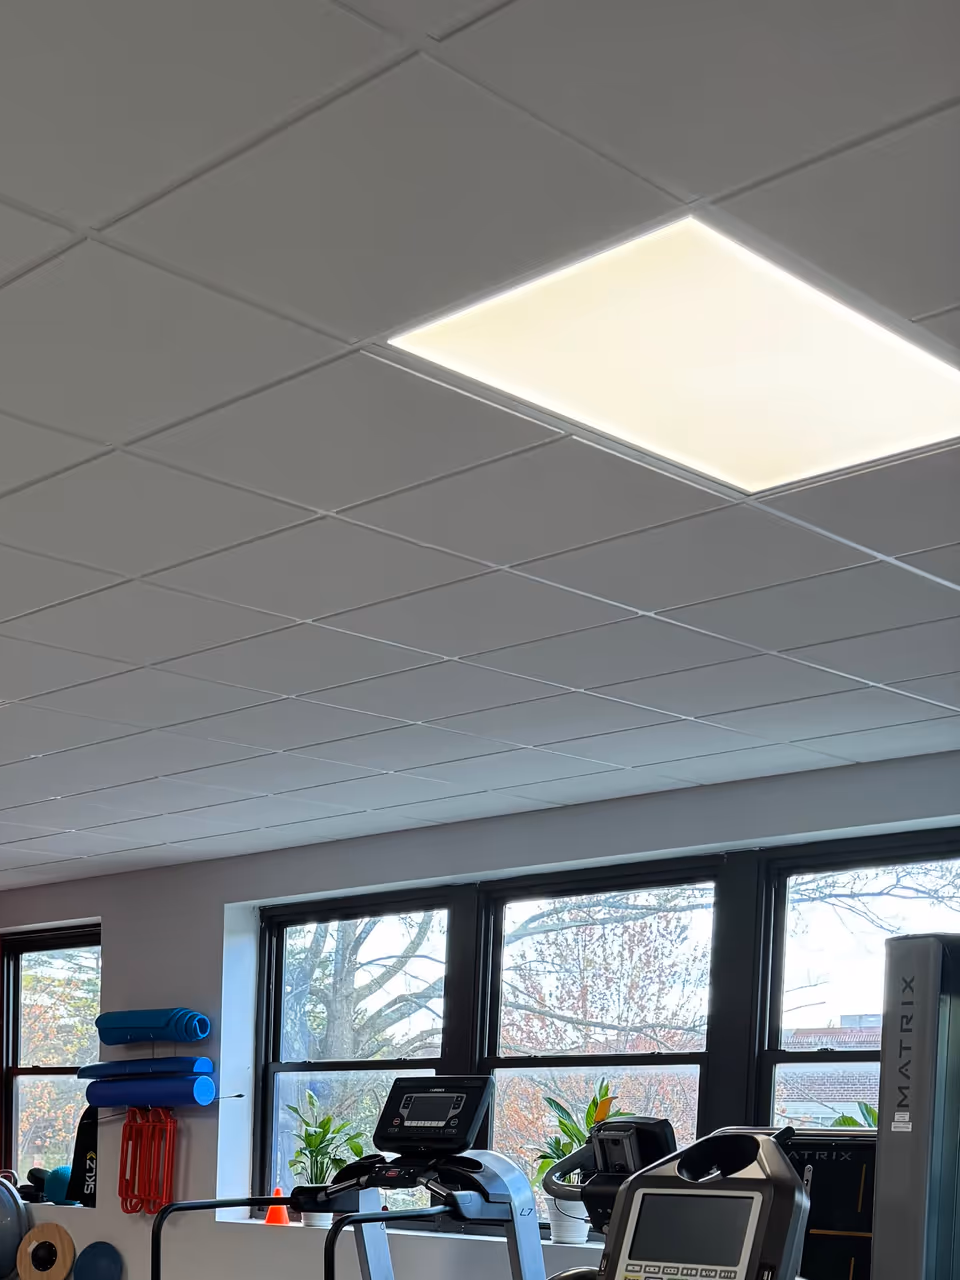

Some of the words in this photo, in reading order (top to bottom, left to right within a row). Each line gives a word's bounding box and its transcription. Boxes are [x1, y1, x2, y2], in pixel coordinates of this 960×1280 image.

[896, 975, 915, 1108] MATRIX
[787, 1150, 852, 1161] ATRIX
[83, 1159, 96, 1194] SKLZ
[519, 1207, 534, 1217] L7
